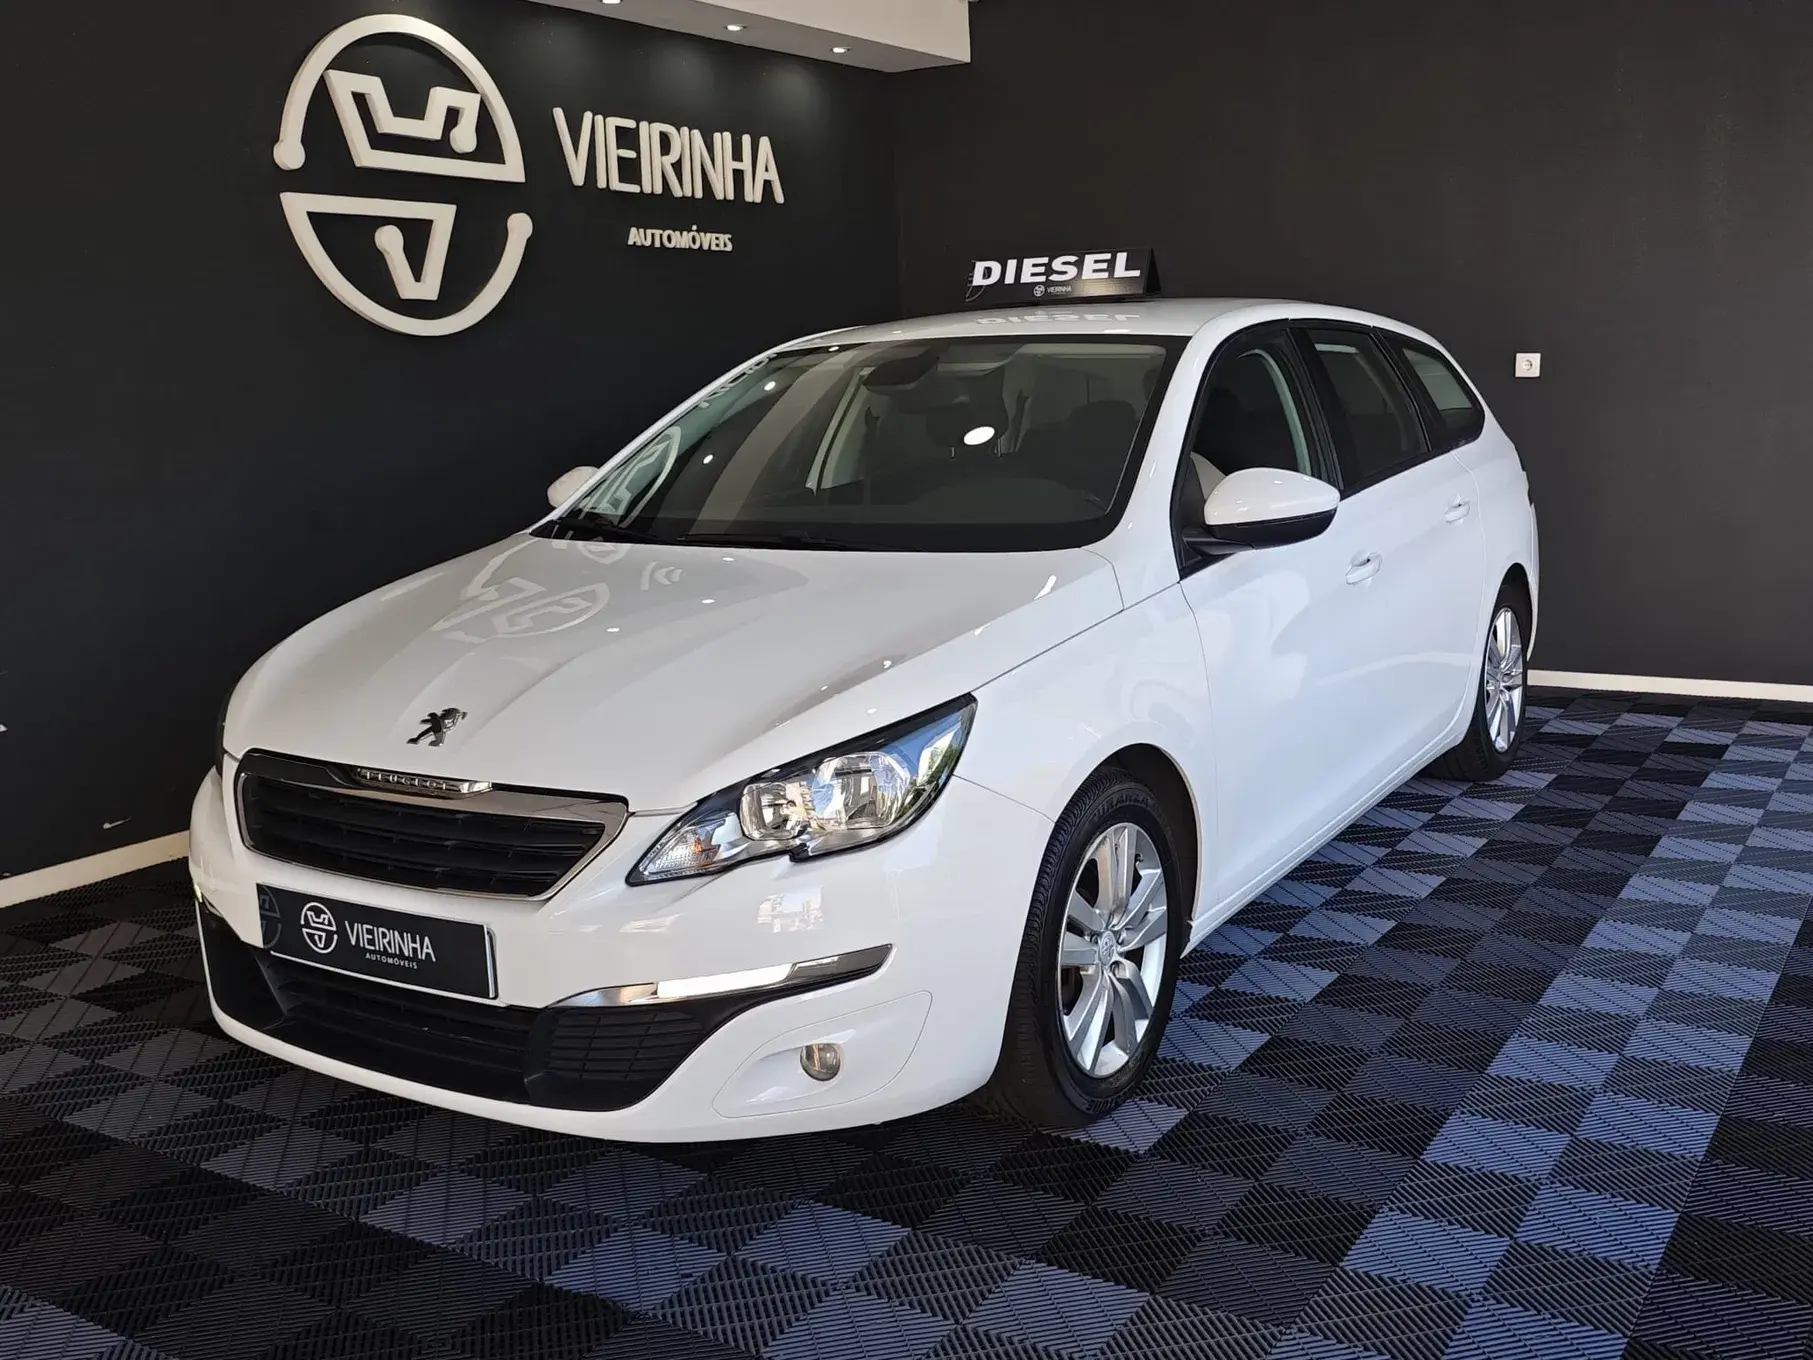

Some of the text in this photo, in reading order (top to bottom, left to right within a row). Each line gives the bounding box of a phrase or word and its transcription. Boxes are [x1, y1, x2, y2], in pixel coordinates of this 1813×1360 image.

[553, 107, 785, 204] VIEIRINHA
[627, 225, 733, 252] AUTOMÓVEIS
[972, 252, 1141, 286] DIESEL
[366, 771, 447, 790] PEUGEOT
[345, 920, 436, 962] VIEIRINHA
[365, 952, 418, 969] AUTOMÓVEIS
